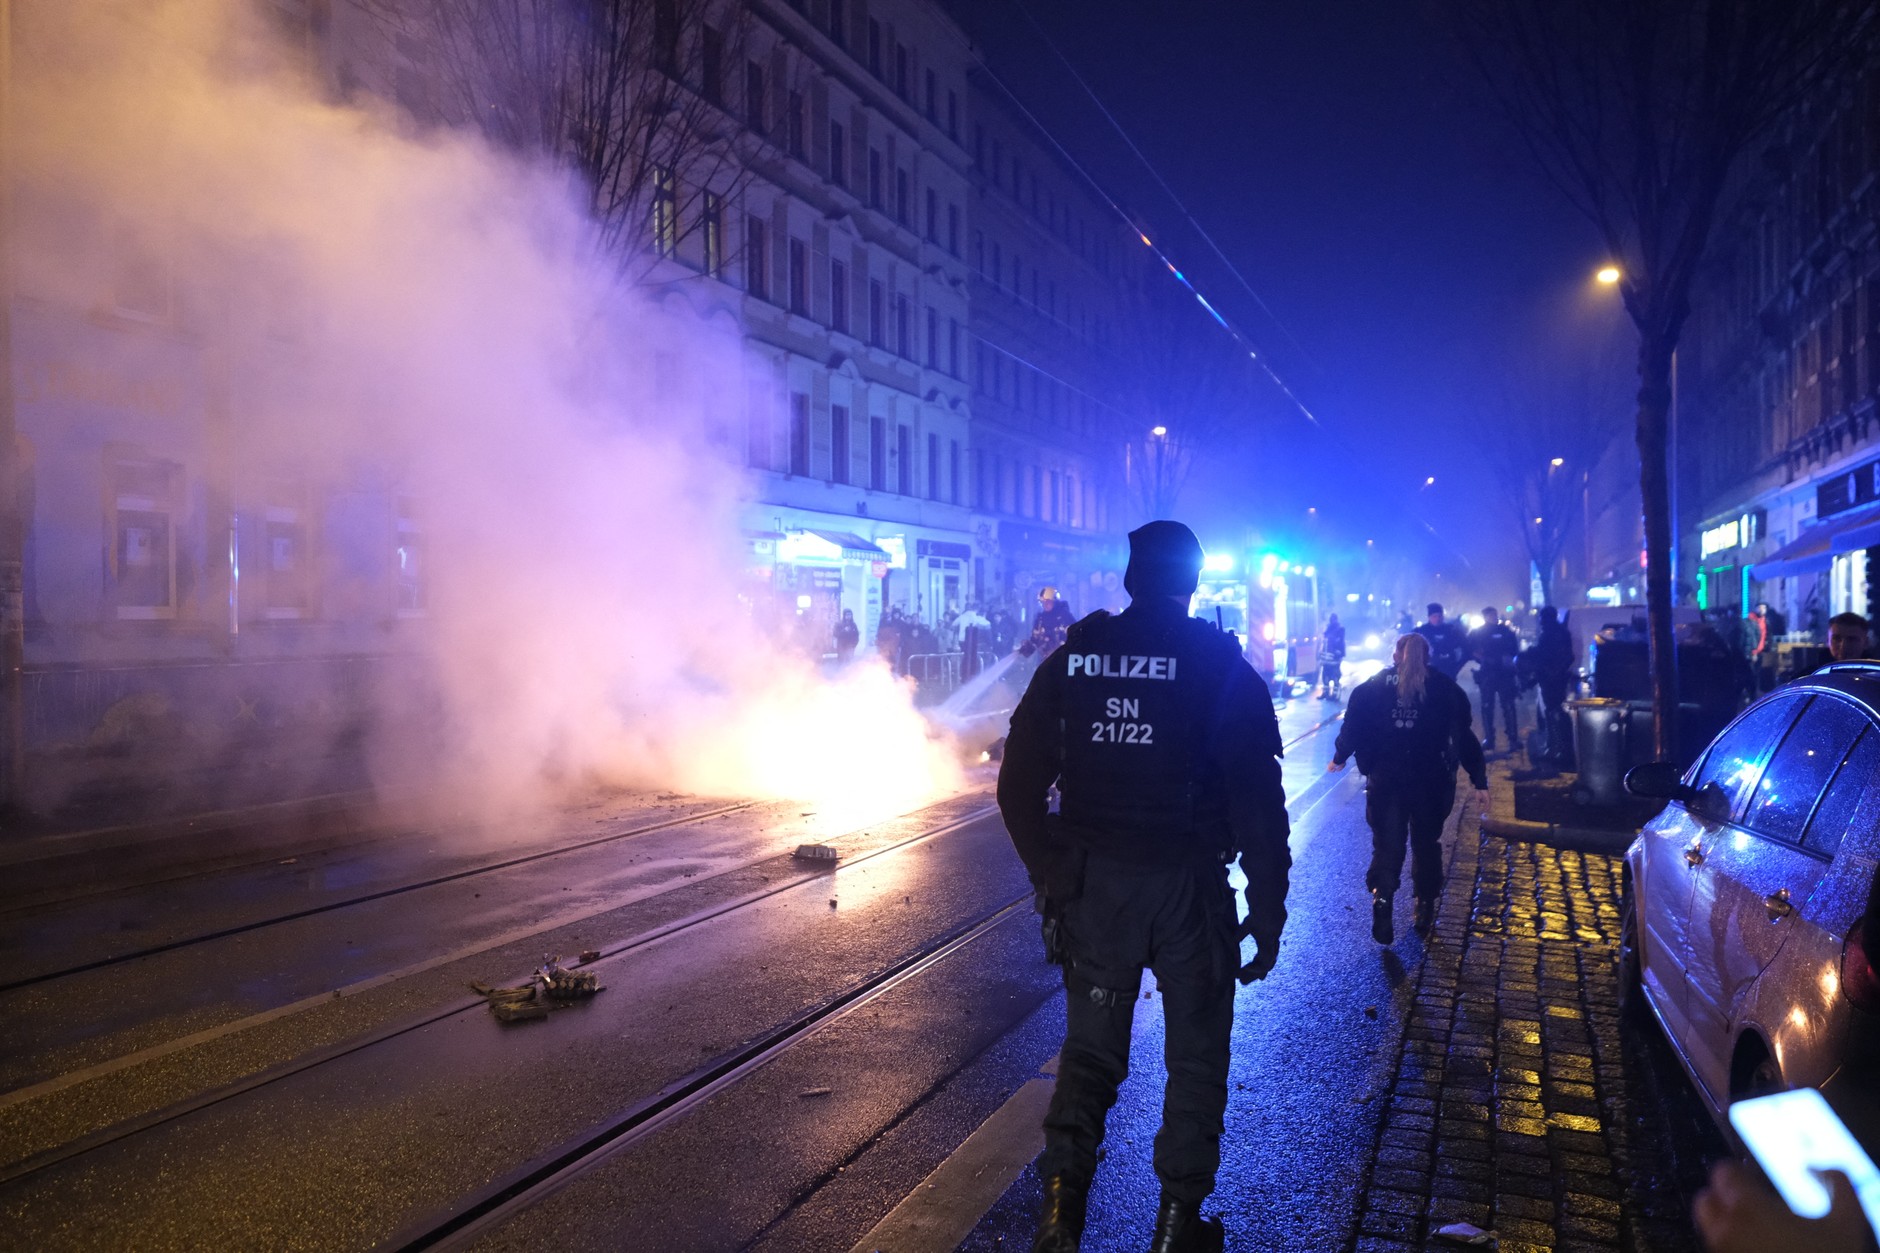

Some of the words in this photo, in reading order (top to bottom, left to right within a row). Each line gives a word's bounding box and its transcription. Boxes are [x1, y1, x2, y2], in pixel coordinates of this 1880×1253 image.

[1067, 654, 1177, 680] POLIZEI
[1105, 697, 1139, 719] SN
[1391, 708, 1418, 719] 21/22
[1091, 721, 1153, 744] 21/22
